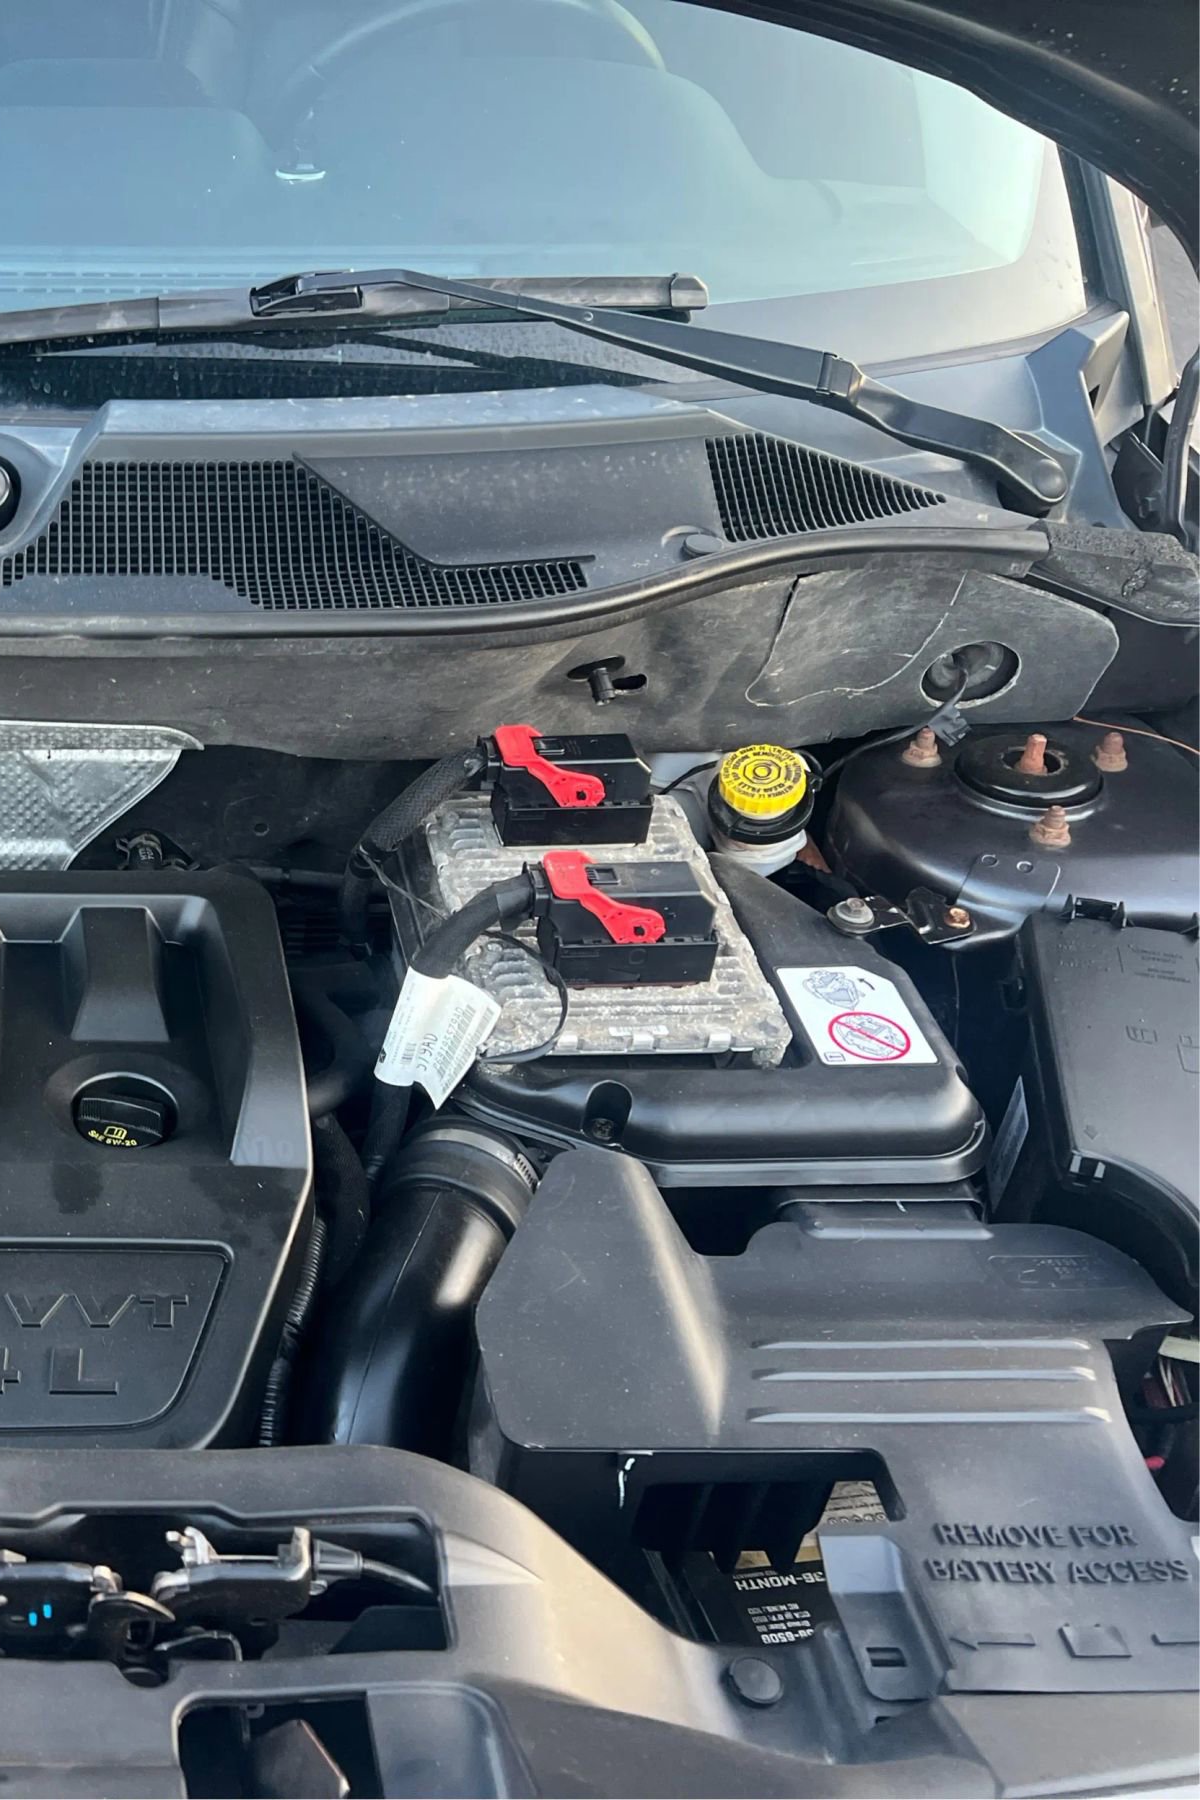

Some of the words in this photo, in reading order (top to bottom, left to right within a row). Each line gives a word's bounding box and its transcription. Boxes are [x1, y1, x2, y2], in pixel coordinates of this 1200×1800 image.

[4, 1292, 189, 1328] VVT
[48, 1346, 119, 1395] L
[934, 1522, 1067, 1548] REMOVE
[1068, 1523, 1138, 1548] FOR
[735, 1571, 826, 1591] 36-MONTH
[925, 1558, 1056, 1584] BATTERY
[1068, 1559, 1193, 1584] ACCESS
